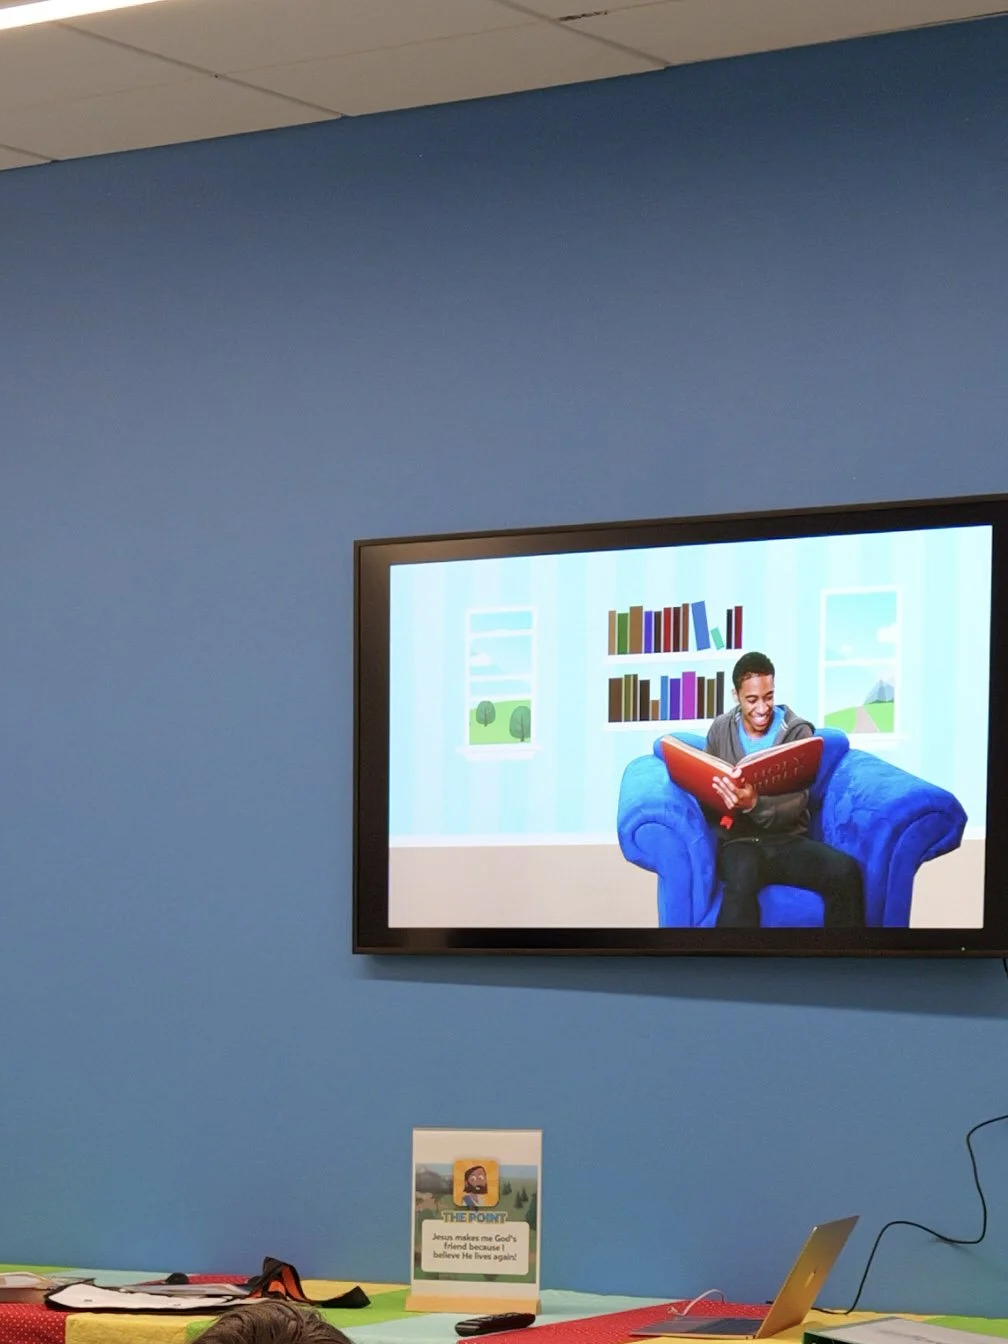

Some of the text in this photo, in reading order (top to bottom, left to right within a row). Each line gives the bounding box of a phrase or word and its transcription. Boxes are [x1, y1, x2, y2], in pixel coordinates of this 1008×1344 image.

[443, 1212, 507, 1224] THE POINT
[432, 1233, 453, 1241] Jesus
[494, 1234, 517, 1243] God's
[444, 1242, 467, 1250] friend
[469, 1243, 500, 1251] because
[433, 1251, 517, 1262] believe He lives again!
